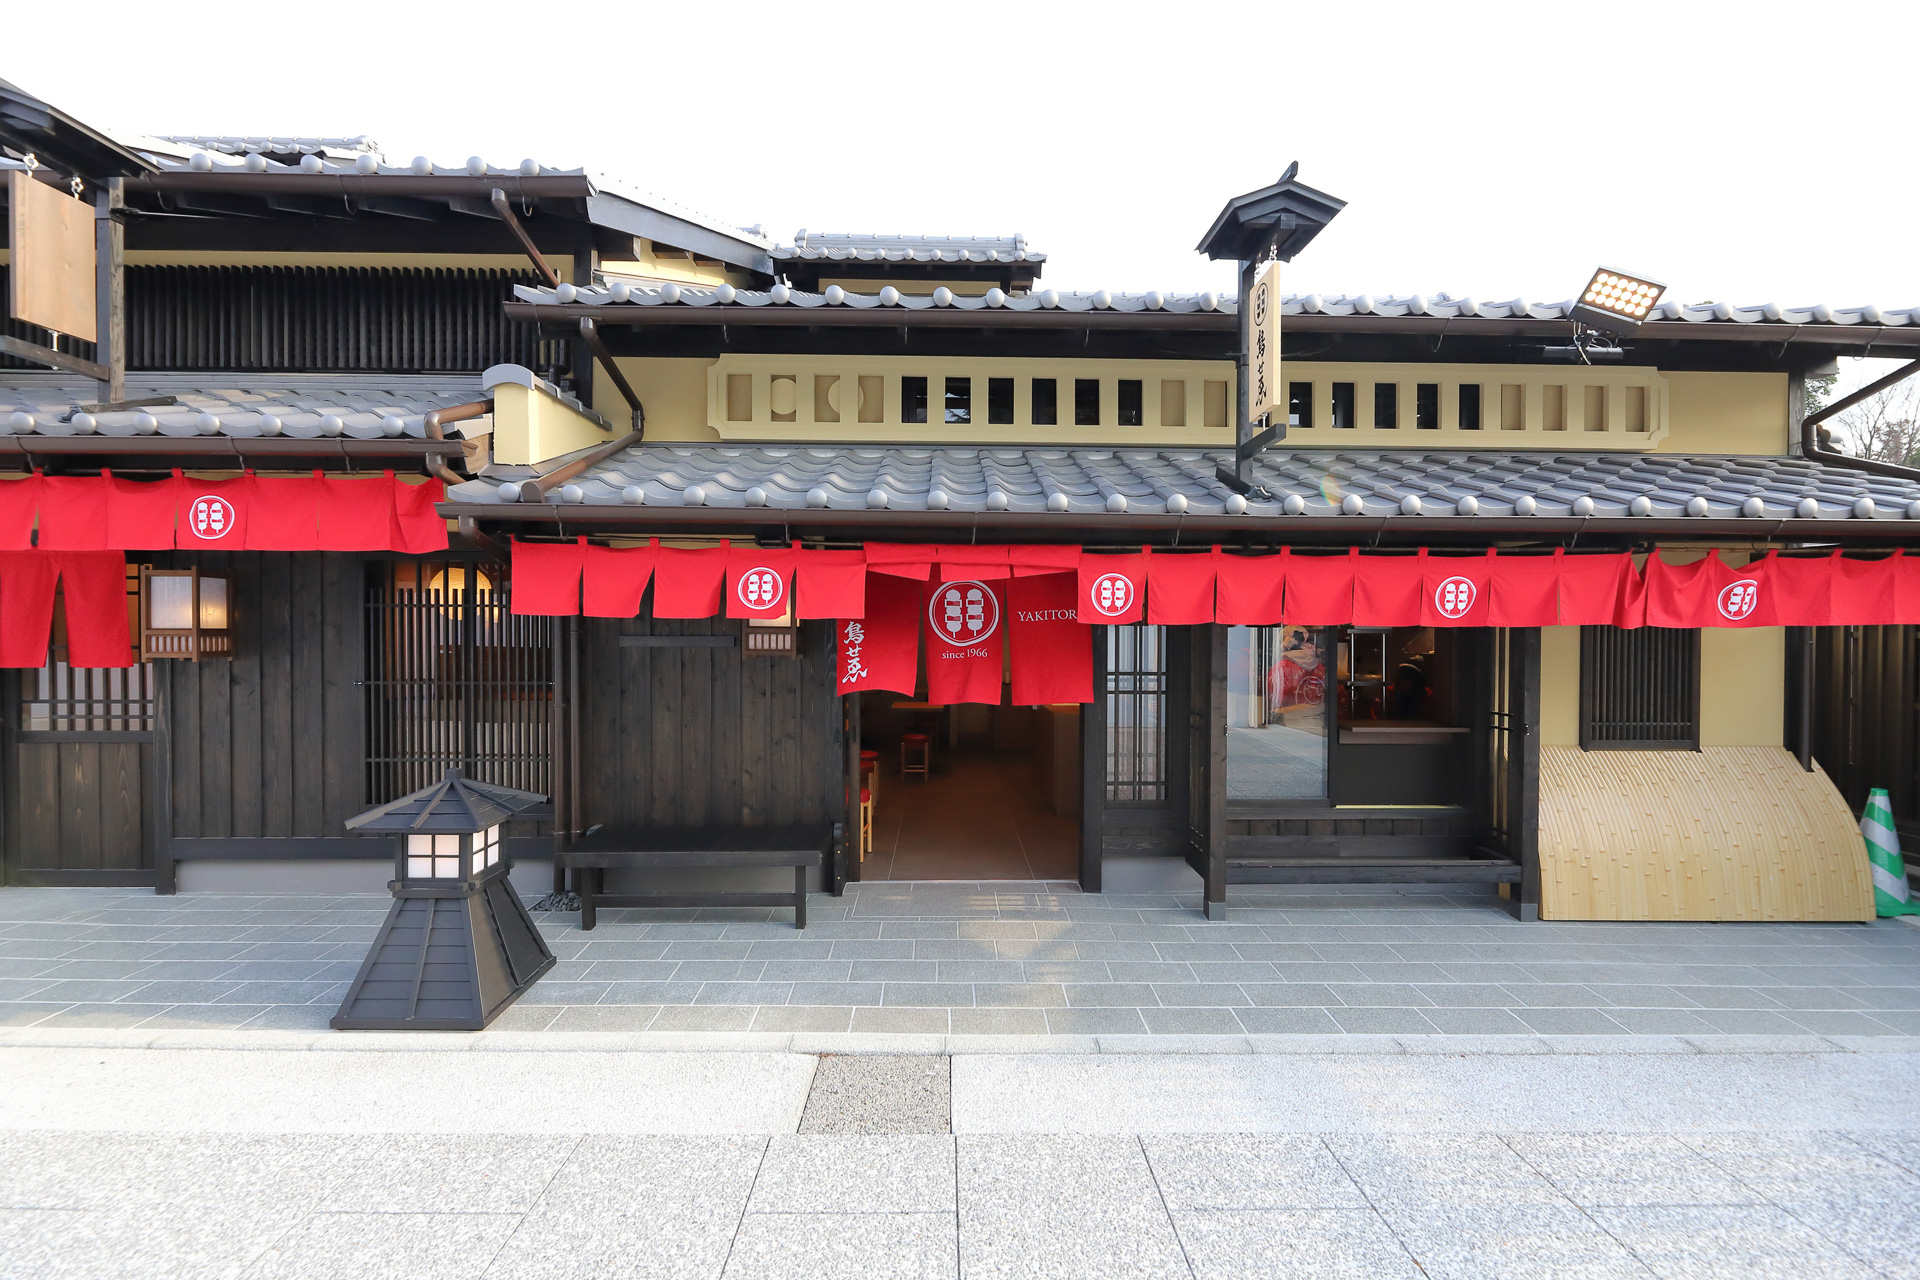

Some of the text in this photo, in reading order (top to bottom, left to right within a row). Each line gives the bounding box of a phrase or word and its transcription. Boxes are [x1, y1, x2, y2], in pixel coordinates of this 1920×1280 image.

[1017, 609, 1078, 622] YAKITOR
[942, 648, 988, 659] since 1966
